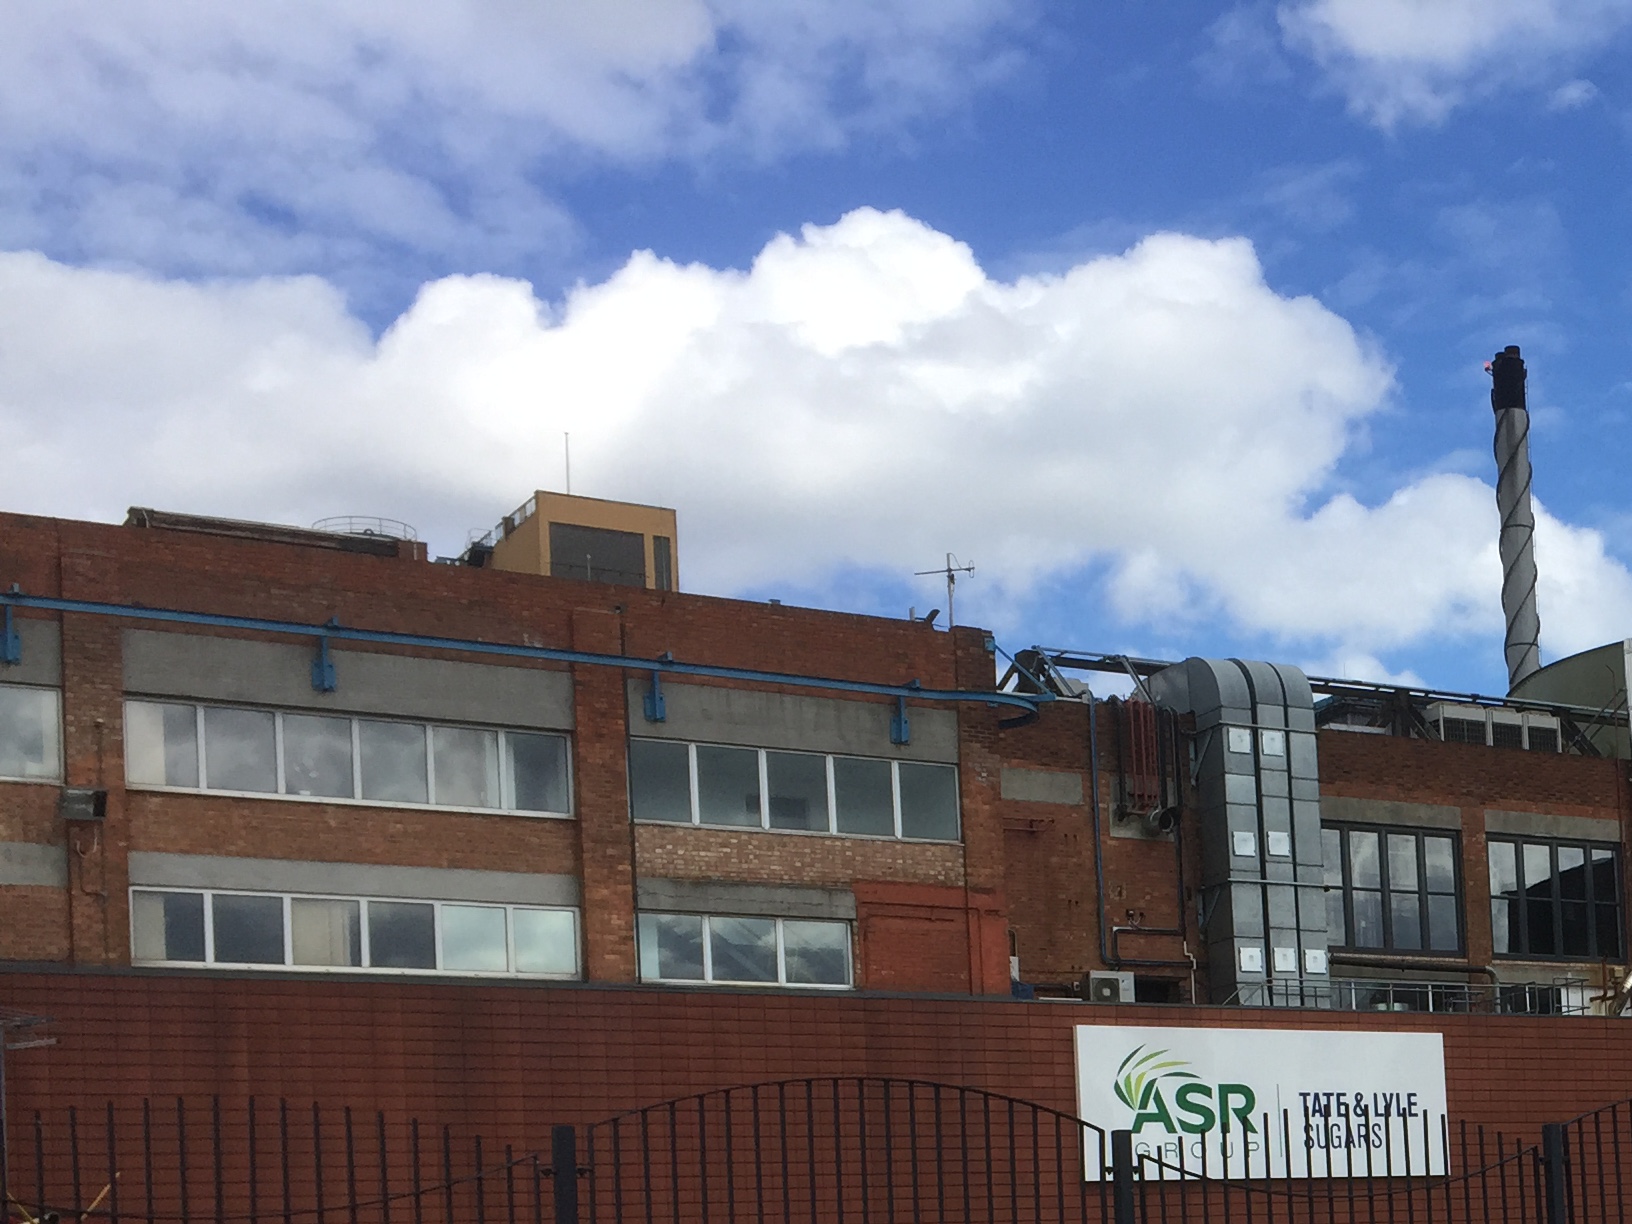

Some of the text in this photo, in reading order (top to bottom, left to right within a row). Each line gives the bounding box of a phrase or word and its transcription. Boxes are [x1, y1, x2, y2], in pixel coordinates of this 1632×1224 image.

[1131, 1079, 1259, 1135] ASR
[1299, 1092, 1419, 1118] TATE & LYLE
[1304, 1123, 1383, 1150] SUGARS
[1135, 1142, 1260, 1160] GROUP
